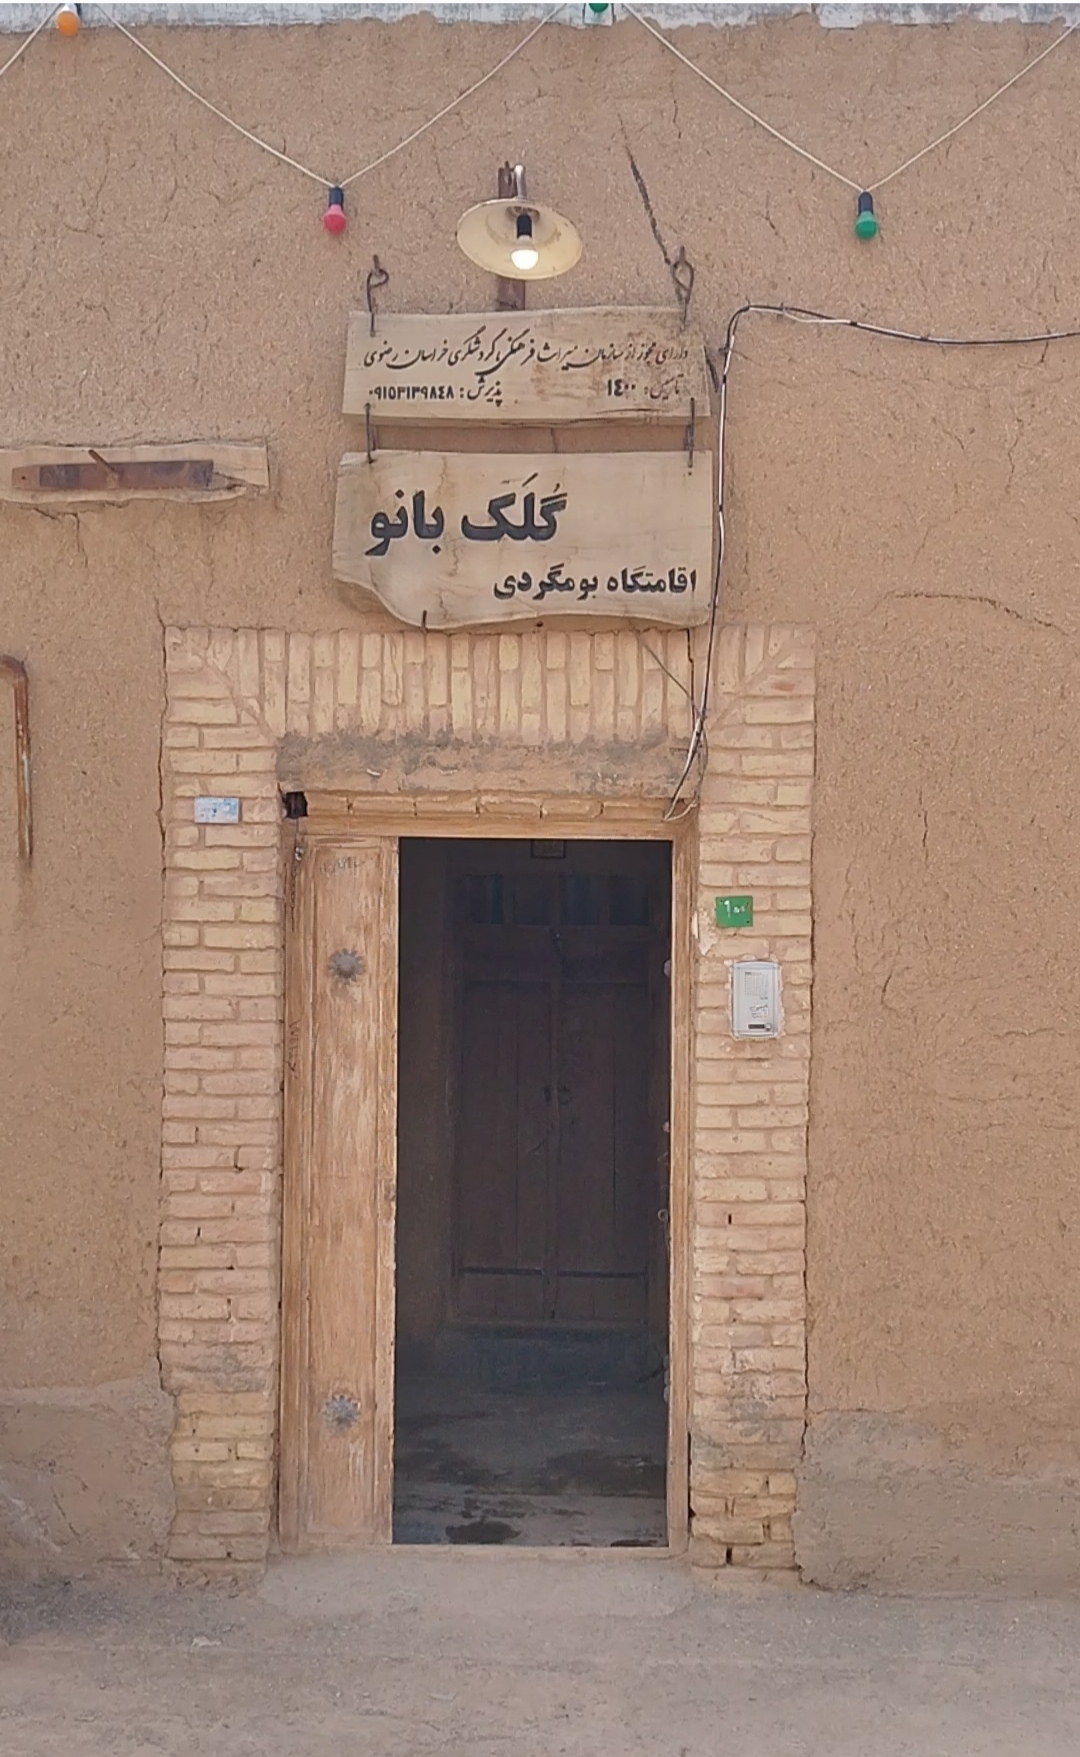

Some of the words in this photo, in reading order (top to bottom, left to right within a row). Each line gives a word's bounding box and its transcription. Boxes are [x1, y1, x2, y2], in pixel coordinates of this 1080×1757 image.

[363, 340, 399, 367] رضوی
[385, 339, 449, 369] خراسان
[447, 325, 508, 366] گردشگری
[536, 341, 579, 371] میراث
[566, 343, 624, 369] سازمان
[624, 343, 636, 361] از
[636, 342, 657, 366] مجوز
[655, 346, 689, 365] دارای
[364, 489, 445, 556] بانو
[493, 563, 599, 601] بومگردی
[606, 565, 697, 594] اقامتگاه
